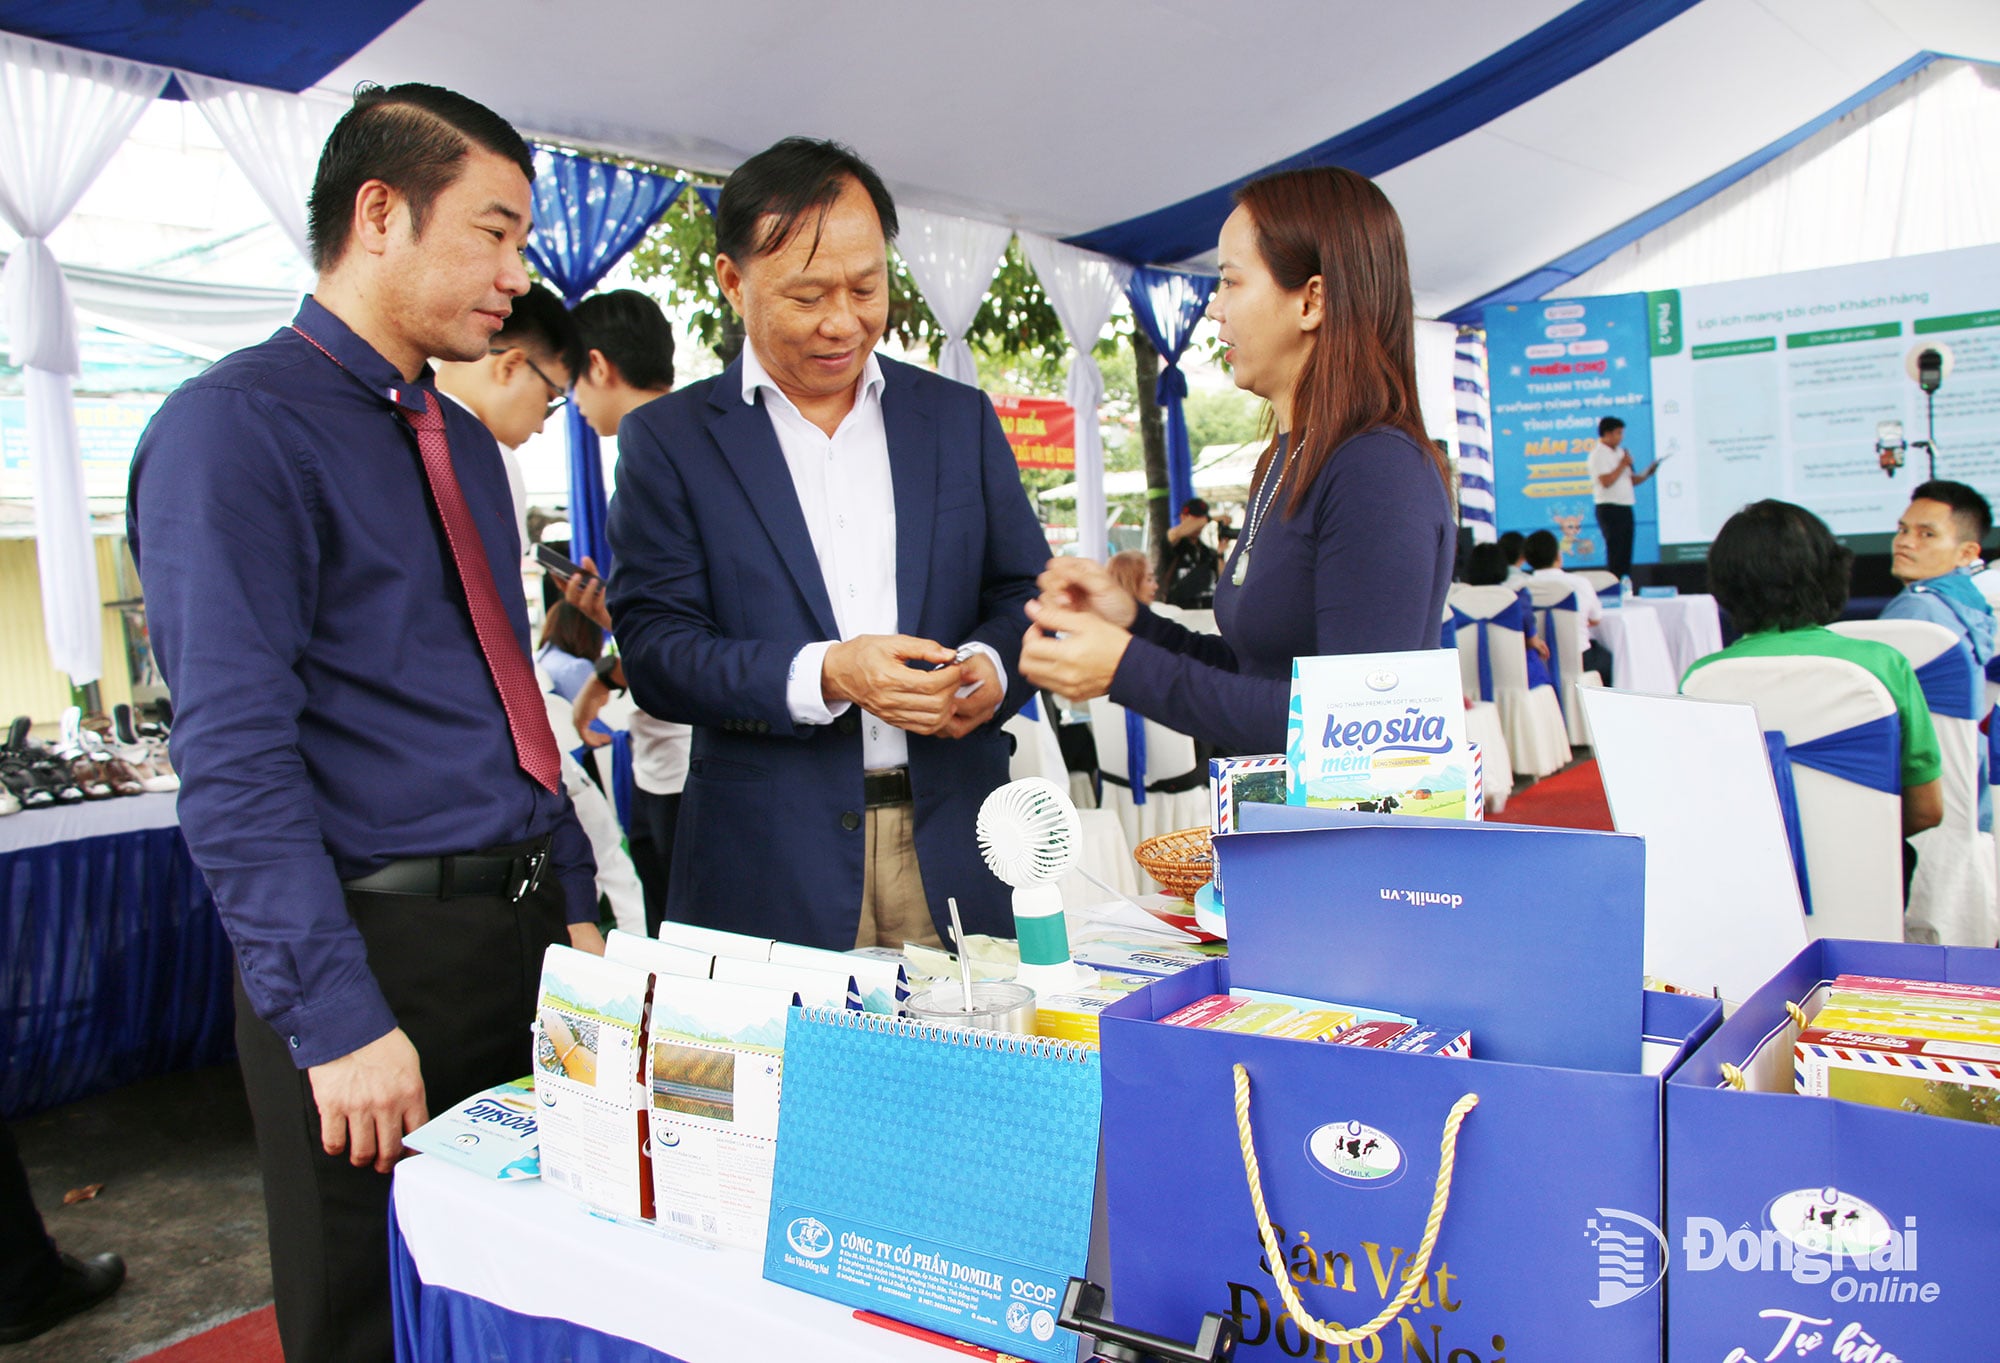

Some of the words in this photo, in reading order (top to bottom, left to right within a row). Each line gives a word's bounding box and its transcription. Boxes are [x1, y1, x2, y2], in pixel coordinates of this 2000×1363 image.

[1745, 311, 1784, 323] mang
[1786, 306, 1806, 318] tới
[1809, 303, 1836, 316] cho
[1839, 295, 1887, 312] Khách
[1890, 291, 1930, 305] hàng
[1659, 335, 1672, 345] 2
[1527, 380, 1572, 395] THANH
[1575, 377, 1611, 392] TOÁN
[1495, 400, 1543, 413] KHÔNG
[1544, 397, 1582, 410] DÙNG
[1584, 392, 1613, 408] TIỀN
[1524, 437, 1568, 456] NĂM
[1365, 699, 1392, 707] PREMIUM
[1322, 713, 1382, 752] kẹo
[1383, 707, 1446, 744] sữa
[1321, 751, 1371, 773] mềm
[1379, 888, 1463, 910] domilk.vn
[1338, 1166, 1371, 1178] DOMILK
[805, 1258, 820, 1274] Đồng
[819, 1264, 830, 1275] Nai
[840, 1230, 873, 1256] CÔNG
[876, 1241, 894, 1260] TY
[893, 1243, 913, 1266] CỔ
[912, 1251, 950, 1277] PHẦN
[950, 1262, 1004, 1293] DOMILK
[1360, 1240, 1462, 1313] Vật
[1011, 1278, 1057, 1304] OCOP
[1758, 1308, 1833, 1363] Tự
